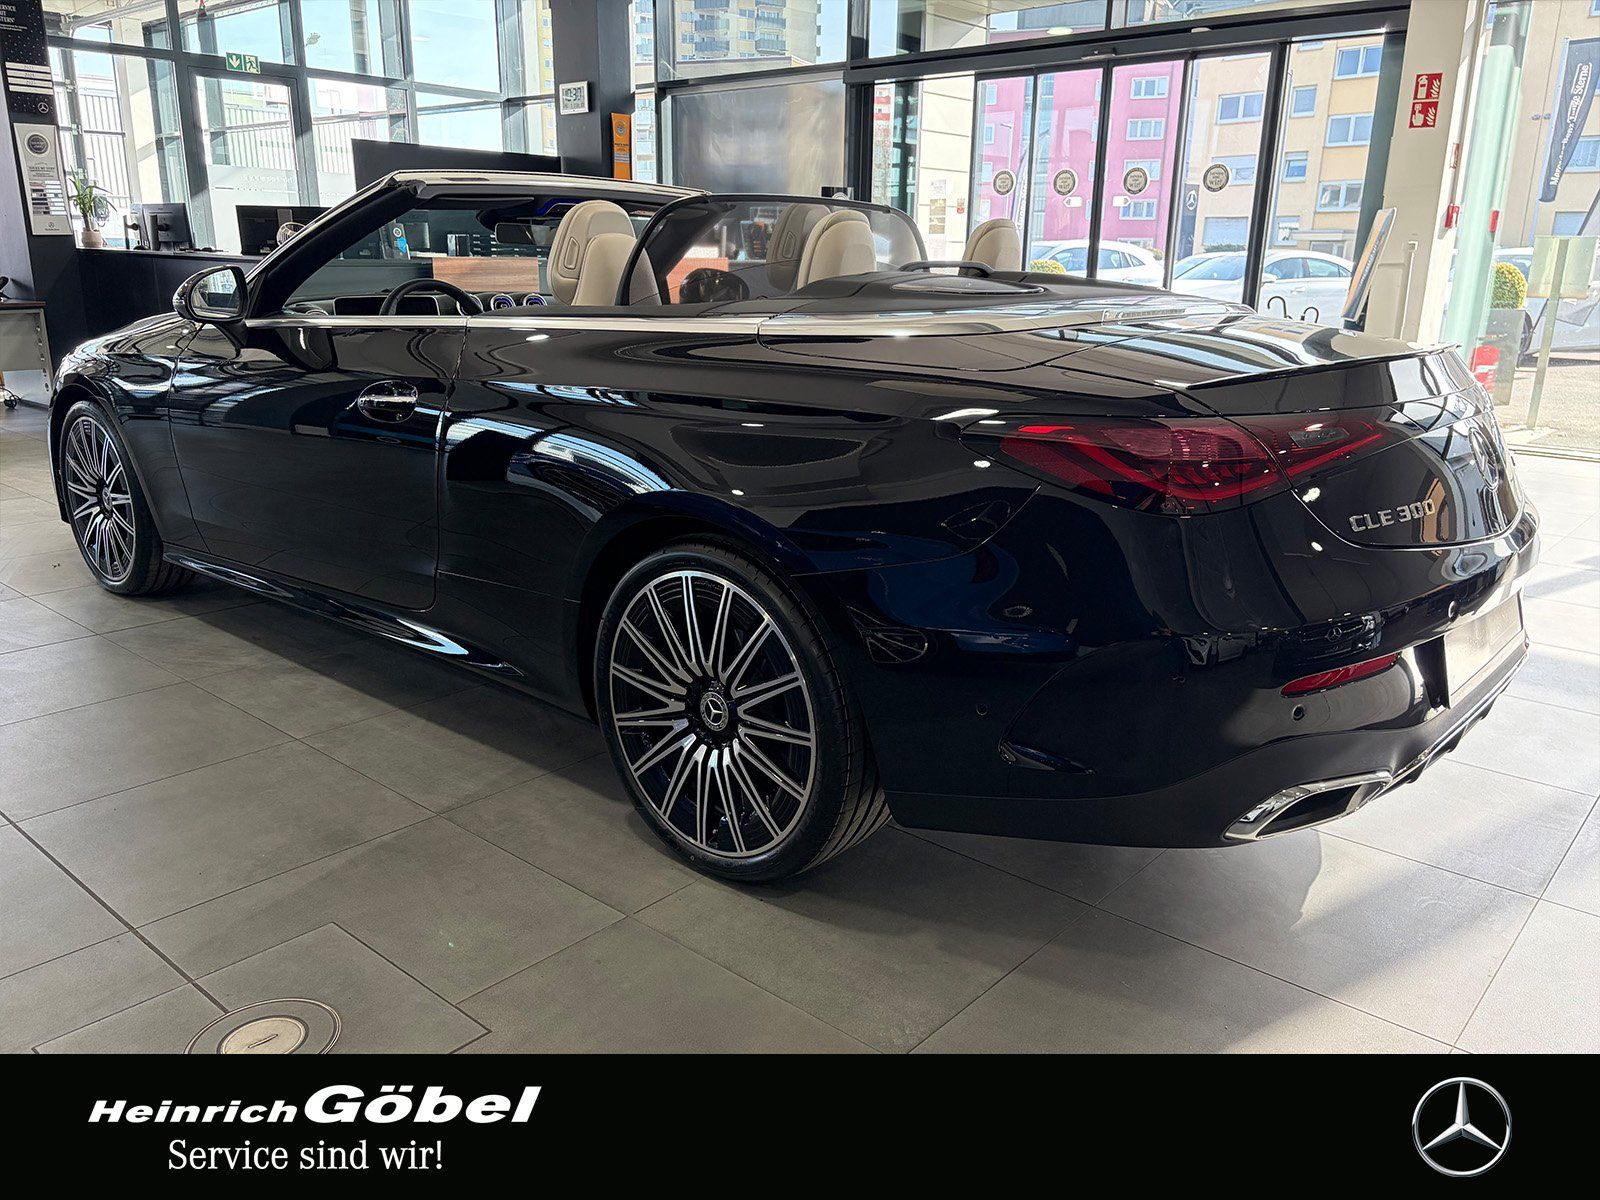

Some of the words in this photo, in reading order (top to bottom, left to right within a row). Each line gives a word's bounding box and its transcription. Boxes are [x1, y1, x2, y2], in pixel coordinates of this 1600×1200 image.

[1574, 64, 1589, 95] Sterne
[1349, 510, 1394, 532] CLE
[1397, 499, 1435, 522] 300
